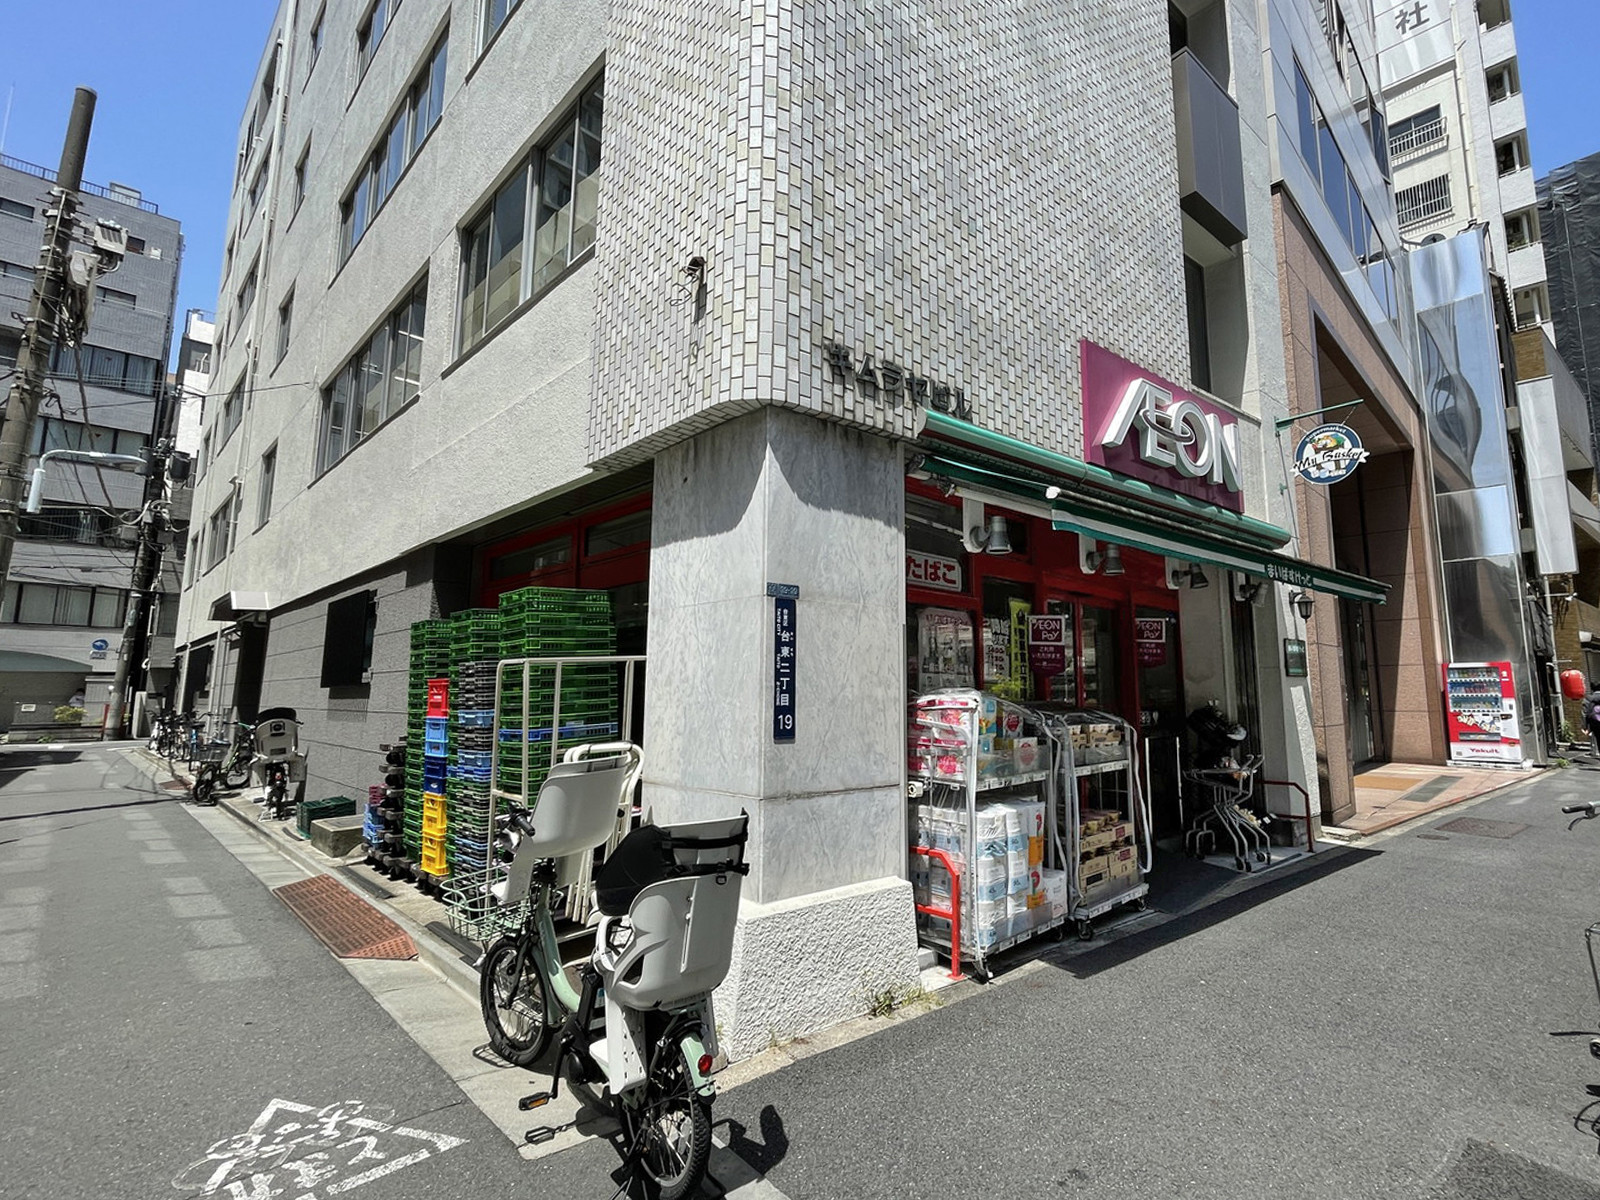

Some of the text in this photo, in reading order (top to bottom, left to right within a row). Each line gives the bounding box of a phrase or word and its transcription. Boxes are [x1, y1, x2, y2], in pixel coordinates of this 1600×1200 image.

[1395, 1, 1430, 35] 社
[1293, 456, 1317, 471] My
[907, 555, 957, 585] たばこ
[1267, 563, 1312, 587] まいばすけっと
[1042, 631, 1060, 641] Pay
[780, 630, 791, 706] 台東二丁目
[777, 714, 793, 730] 19
